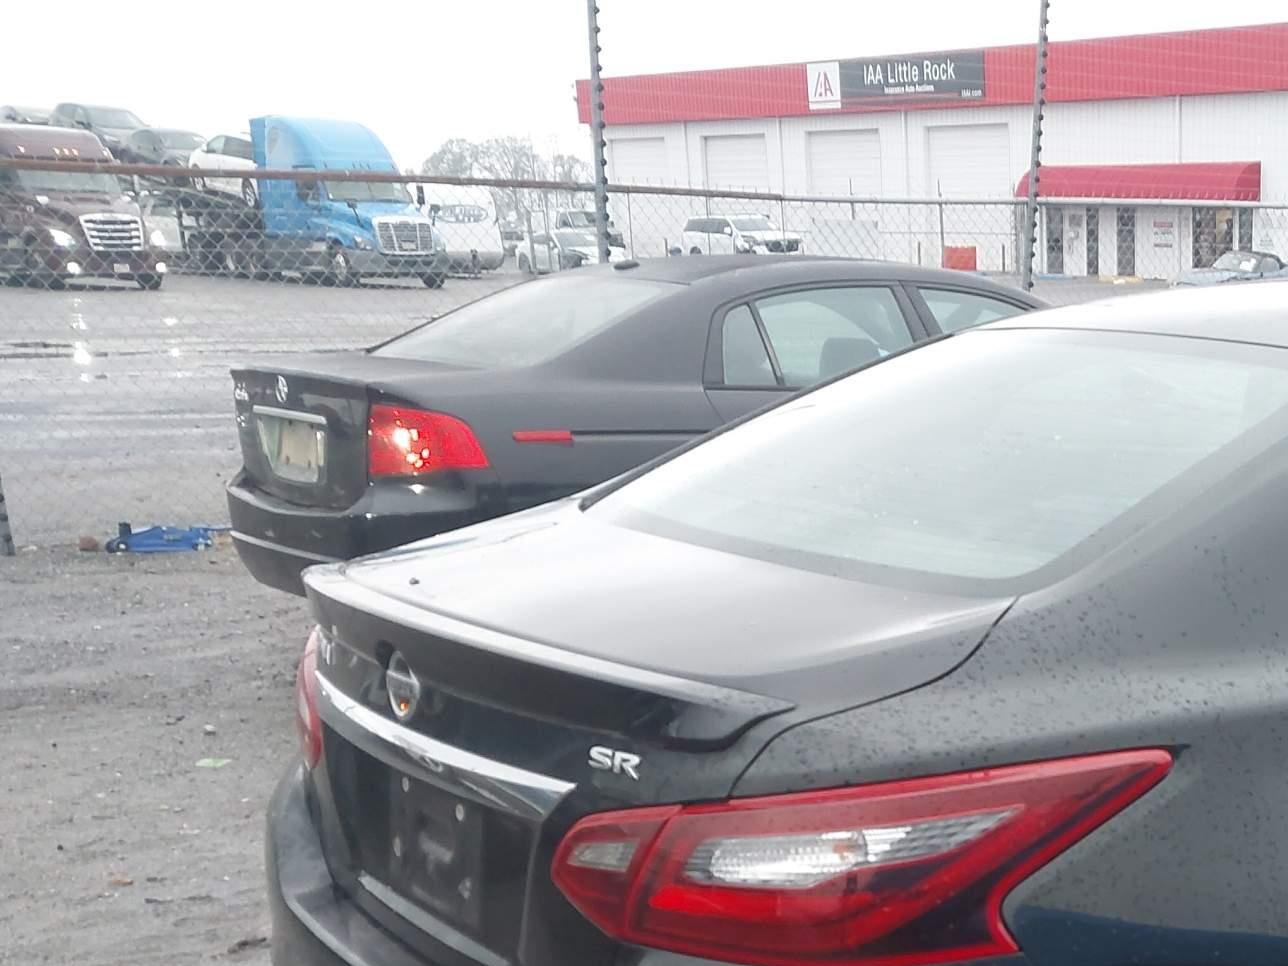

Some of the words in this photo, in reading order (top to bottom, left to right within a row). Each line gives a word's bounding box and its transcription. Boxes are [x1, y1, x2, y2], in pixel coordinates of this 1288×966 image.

[864, 64, 884, 86] IAA
[887, 61, 919, 83] Little
[923, 58, 956, 81] Rock
[588, 746, 641, 780] SR
